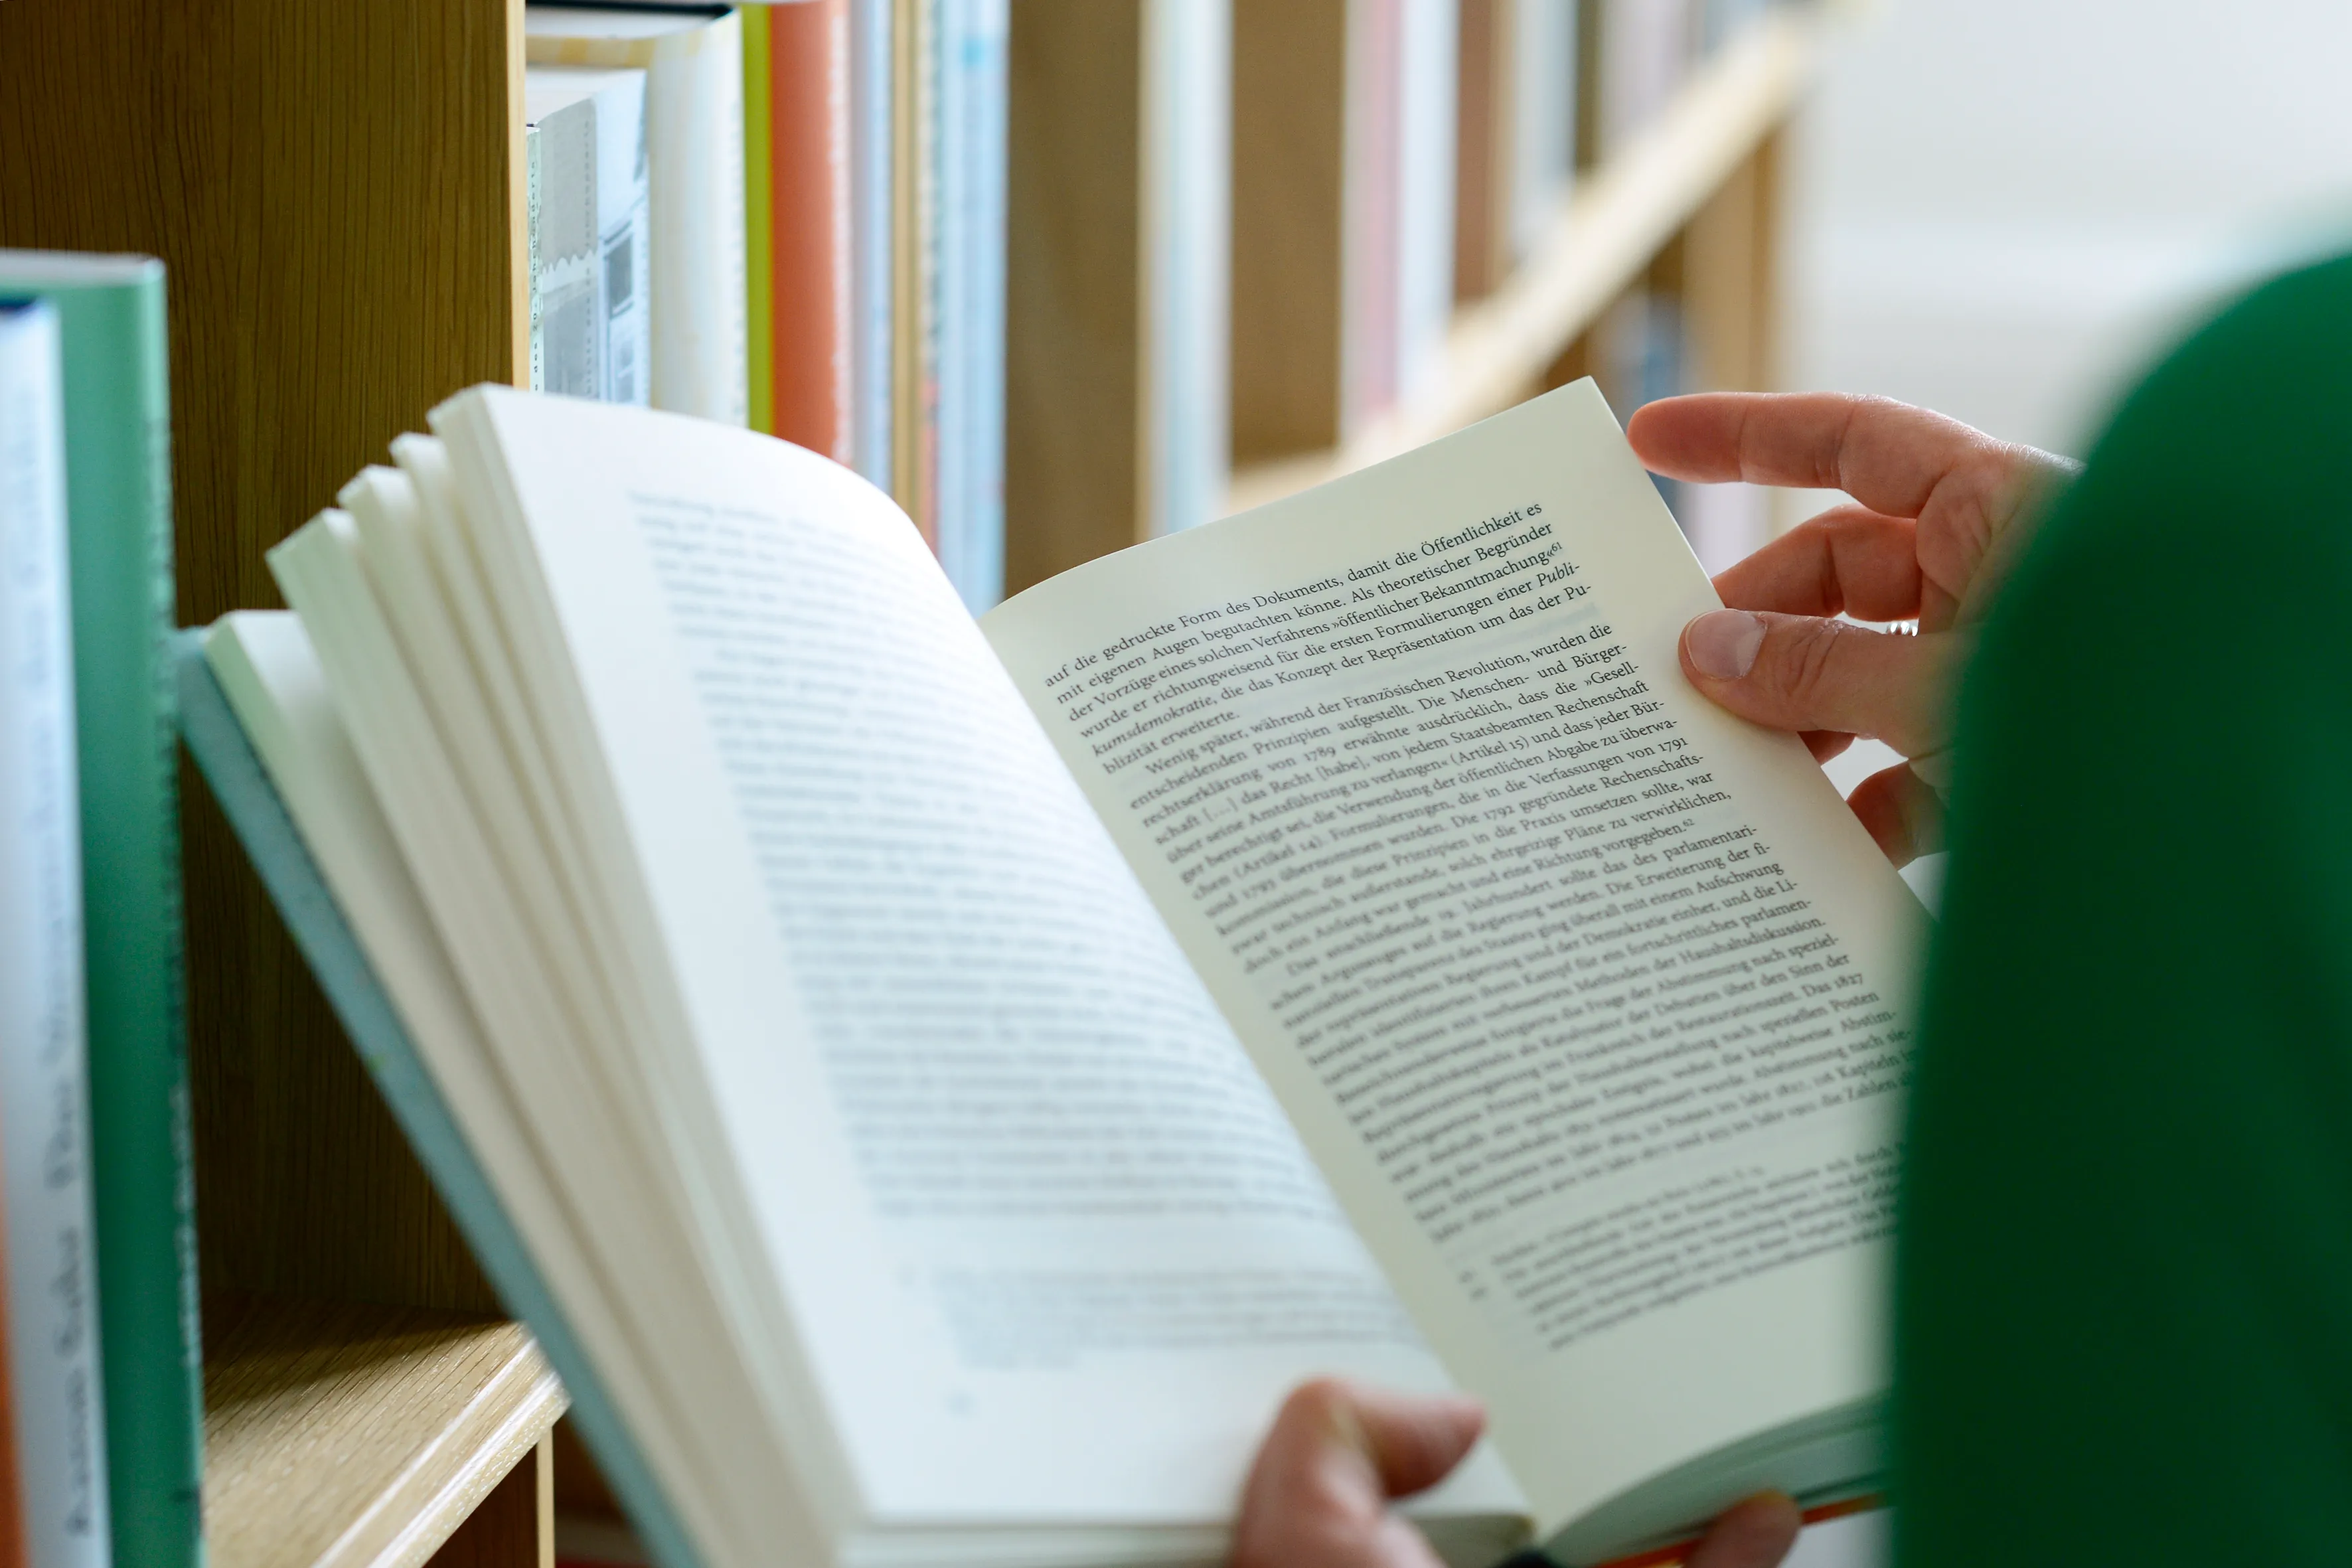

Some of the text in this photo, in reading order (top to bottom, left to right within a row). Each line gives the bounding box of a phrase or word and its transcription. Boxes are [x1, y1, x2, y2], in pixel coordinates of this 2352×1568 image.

[1045, 504, 1542, 687] auf die gedruckte Form des Dokuments, damit die Öffentlichkeit es
[1057, 524, 1553, 704] mit eigenen Augen begutachten könne. Als theoretischer Begründer
[1069, 702, 1093, 722] der
[1093, 674, 1158, 705] Vorzüge
[1158, 659, 1197, 678] eines
[1198, 639, 1253, 665] solchen
[1251, 623, 1330, 647] Verfahrens
[1080, 562, 1580, 738] wurde er richtungweisend für die ersten Formulierungen einer Publi-
[1091, 586, 1591, 757] kumsdemokratie, die das Konzept der Repräsentation um das der Pu-
[1130, 645, 1627, 810] entscheidenden Prinzipien aufgestellt. Die Menschen- und Bürger-
[1144, 625, 1612, 774] Wenig später, während der Französischen Revolution, wurden die
[1102, 711, 1240, 774] blizität erweiterte.
[1142, 768, 1263, 828] rechtserklärung
[1267, 757, 1297, 771] von
[1303, 746, 1336, 761] 1789
[1343, 728, 1411, 750] erwähnte
[1417, 700, 1512, 732] ausdrücklich,
[1518, 691, 1549, 705] dass
[1555, 682, 1578, 695] die
[1241, 789, 1267, 805] das
[1269, 773, 1314, 794] Recht
[1372, 750, 1402, 763] von
[1402, 738, 1449, 759] jedem
[1450, 711, 1555, 744] Staatsbeamten
[1553, 680, 1650, 716] Rechenschaft
[1350, 779, 1370, 791] zu
[1450, 740, 1508, 765] (Artikel
[1508, 735, 1529, 750] 15)
[1531, 726, 1562, 744] und
[1563, 721, 1594, 735] dass
[1593, 710, 1630, 730] jeder
[1629, 701, 1664, 716] Bür-
[1432, 777, 1456, 791] der
[1458, 755, 1545, 783] öffentlichen
[1547, 740, 1600, 761] Abgabe
[1600, 735, 1620, 746] zu
[1619, 720, 1678, 741] überwa-
[1458, 738, 1689, 805] die in die Verfassungen von 1791
[1450, 754, 1704, 828] Die 1792 gegründete Rechenschafts-
[1472, 773, 1713, 844] in die Praxis umsetzen sollte, war
[1563, 824, 1607, 841] Pläne
[1608, 818, 1628, 830] zu
[1630, 791, 1731, 823] verwirklichen,
[1532, 844, 1604, 871] Richtung
[1602, 861, 1628, 874] das
[1632, 853, 1658, 866] des
[1662, 824, 1757, 862] parlamentari-
[1605, 842, 1770, 896] Die Erweiterung der fi-
[1621, 863, 1784, 913] mit einem Aufschwung
[1670, 879, 1798, 922] einher, und die Li-
[1740, 900, 1812, 929] parlamen-
[1800, 982, 1832, 998] Das
[1826, 954, 1849, 969] der
